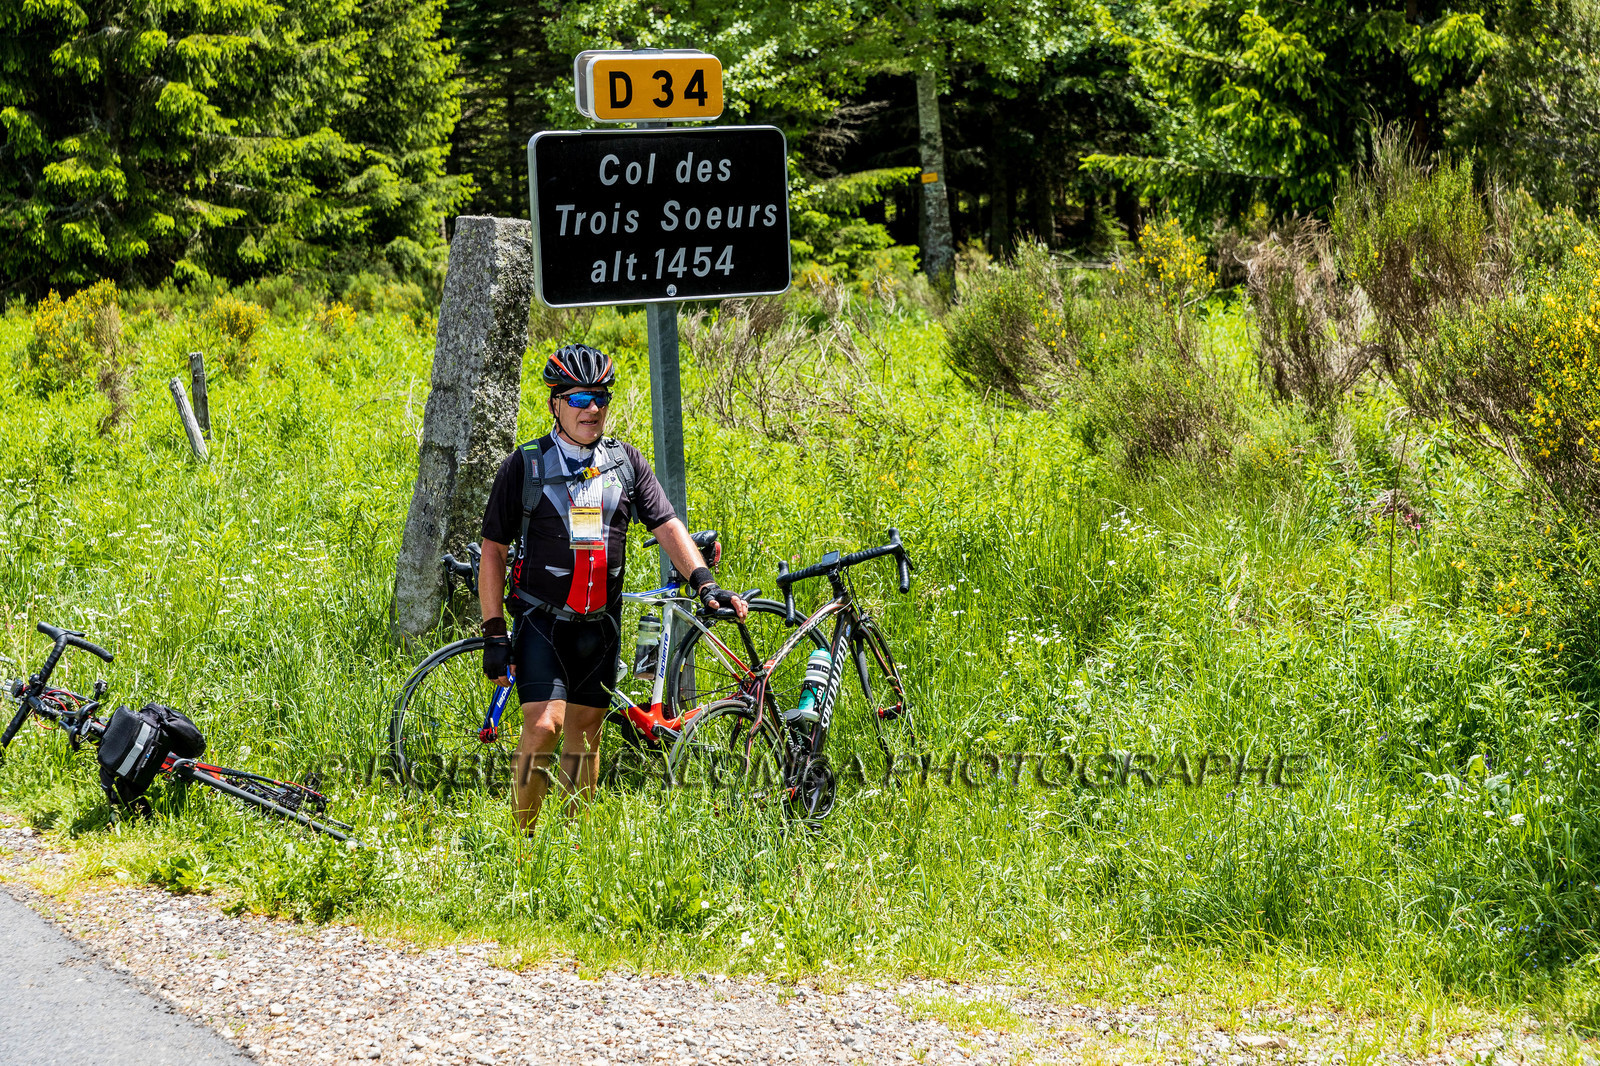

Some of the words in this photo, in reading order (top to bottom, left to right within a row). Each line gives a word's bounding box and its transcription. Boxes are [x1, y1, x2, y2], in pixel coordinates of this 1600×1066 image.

[608, 71, 633, 109] D
[652, 69, 708, 108] 34
[599, 152, 656, 186] Col
[675, 151, 732, 183] des
[555, 202, 640, 237] Trois
[660, 200, 778, 232] Soeurs
[658, 632, 669, 679] lapierre
[820, 635, 848, 728] SPECIALIZED
